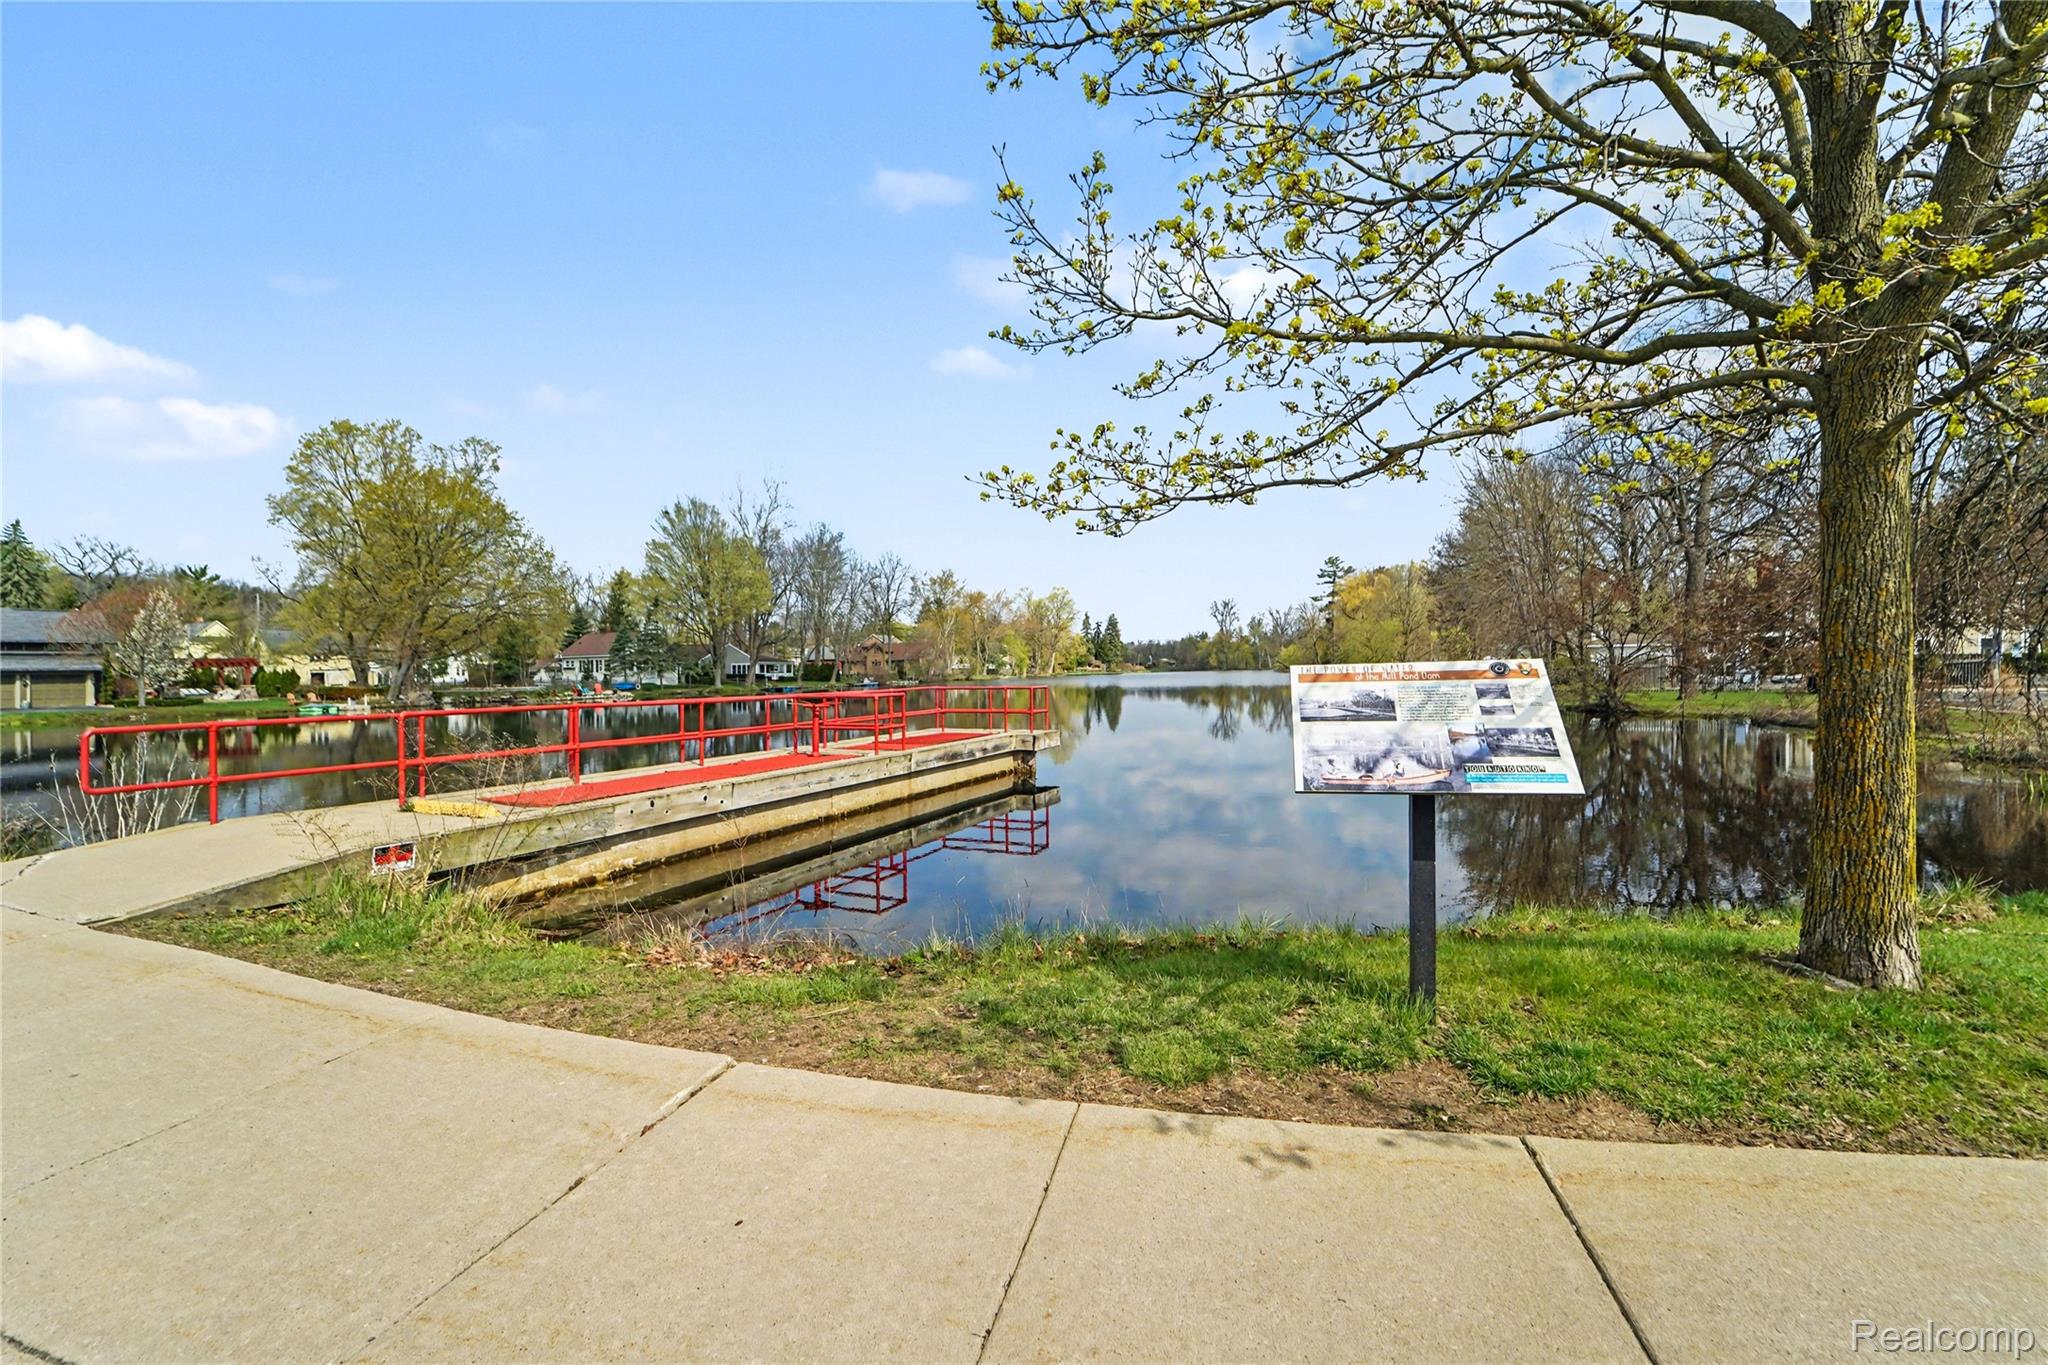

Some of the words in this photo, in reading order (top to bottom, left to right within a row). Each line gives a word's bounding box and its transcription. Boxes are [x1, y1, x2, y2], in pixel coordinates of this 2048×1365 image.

[1300, 666, 1317, 675] THE
[1323, 665, 1357, 674] POWER
[1362, 665, 1374, 674] OF
[1399, 671, 1419, 681] Pond
